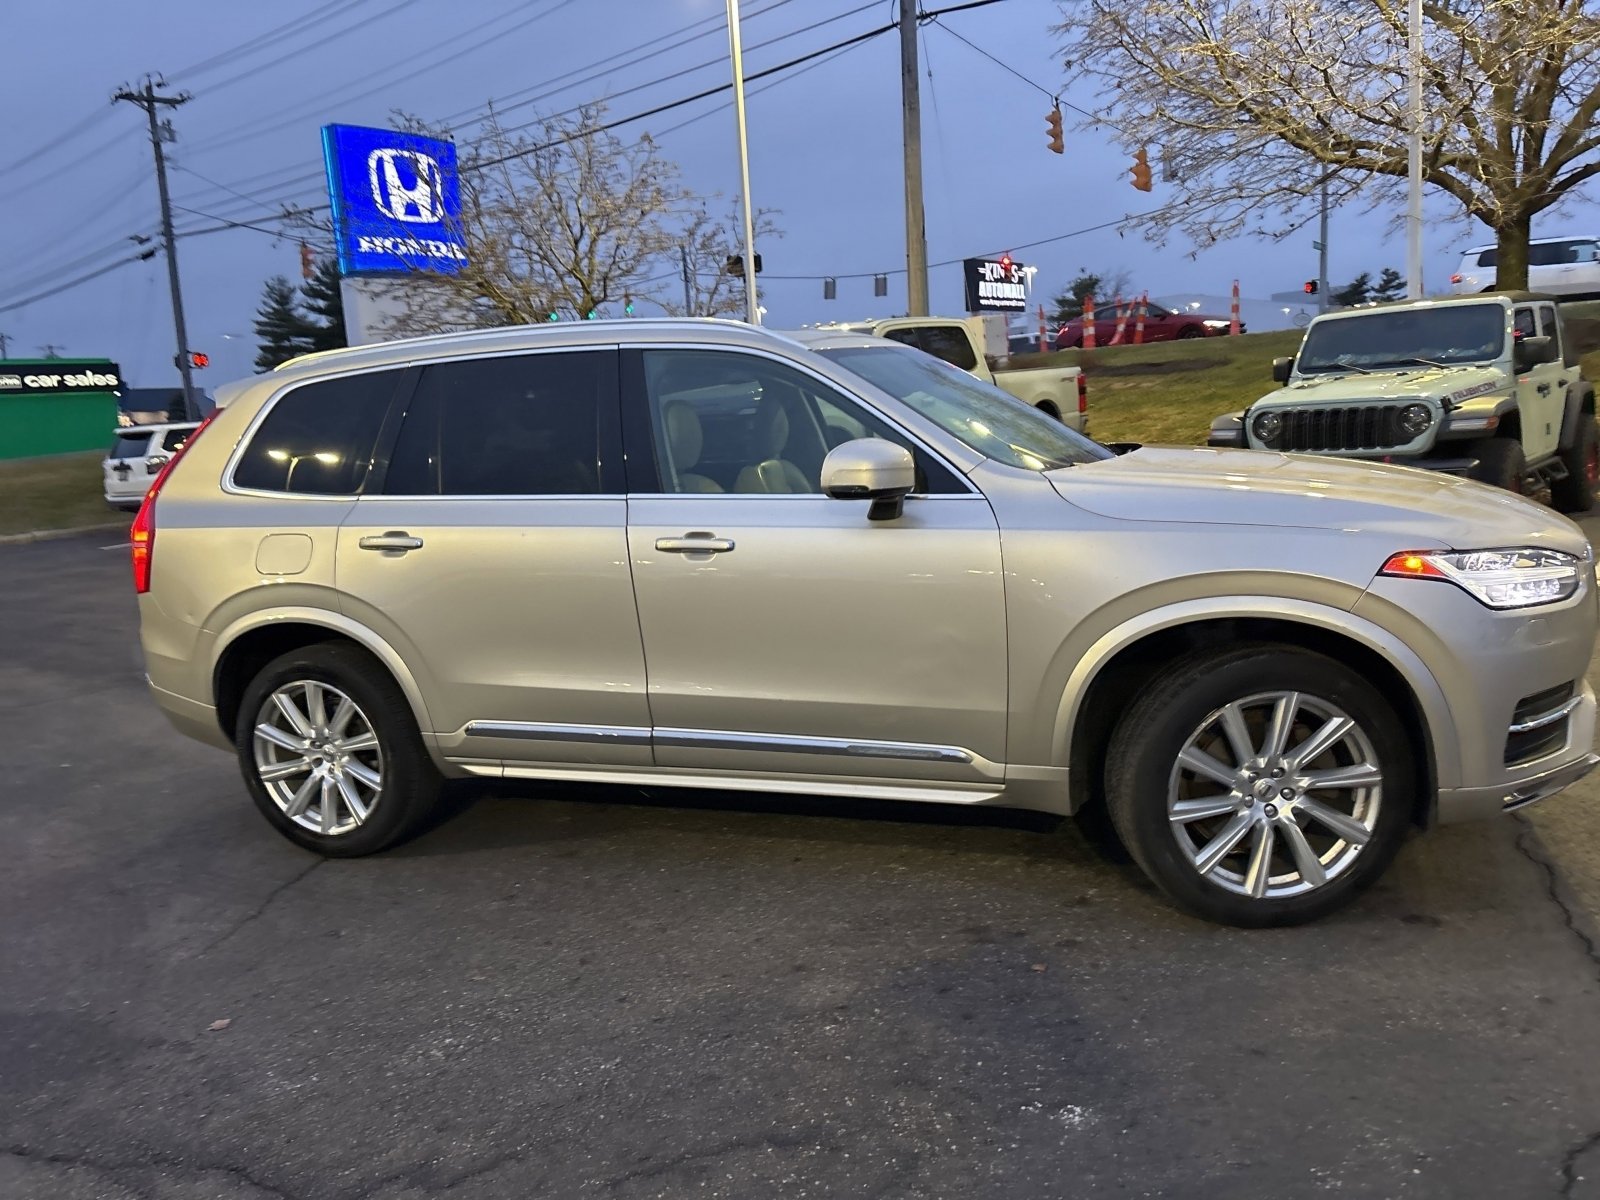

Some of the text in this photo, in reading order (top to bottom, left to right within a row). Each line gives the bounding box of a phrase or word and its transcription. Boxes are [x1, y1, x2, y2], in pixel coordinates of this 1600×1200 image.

[358, 236, 466, 260] HONDA
[978, 281, 1026, 300] AUTOMALL
[24, 375, 61, 388] car
[63, 370, 119, 387] sales
[1451, 381, 1497, 400] RUBICON
